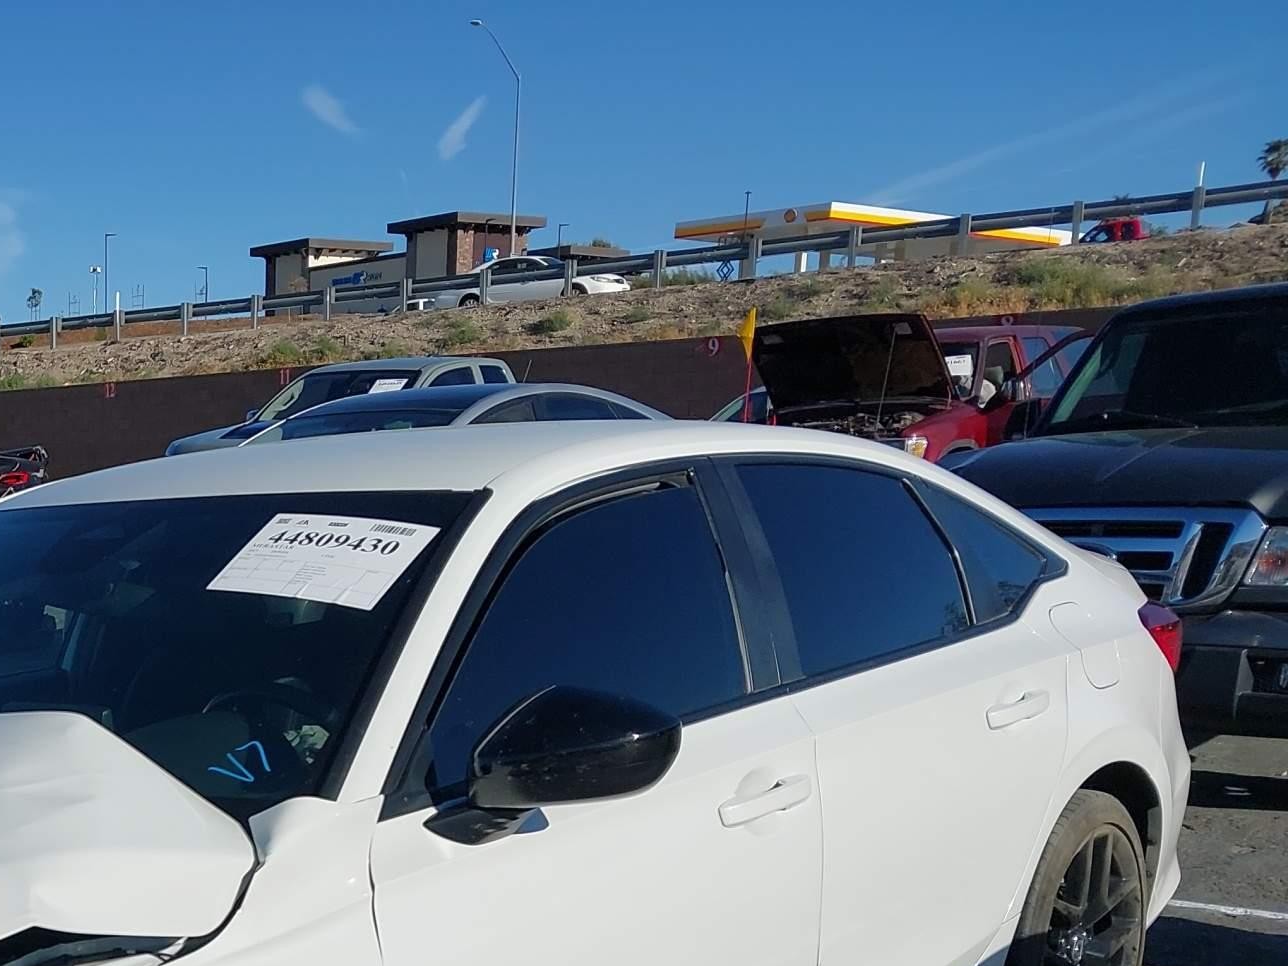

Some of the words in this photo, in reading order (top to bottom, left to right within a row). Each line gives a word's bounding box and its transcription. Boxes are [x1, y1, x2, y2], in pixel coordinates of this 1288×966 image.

[708, 337, 720, 357] 9
[279, 368, 290, 385] 11
[105, 383, 116, 398] 12
[268, 530, 401, 555] 44809430
[207, 740, 272, 783] V7
